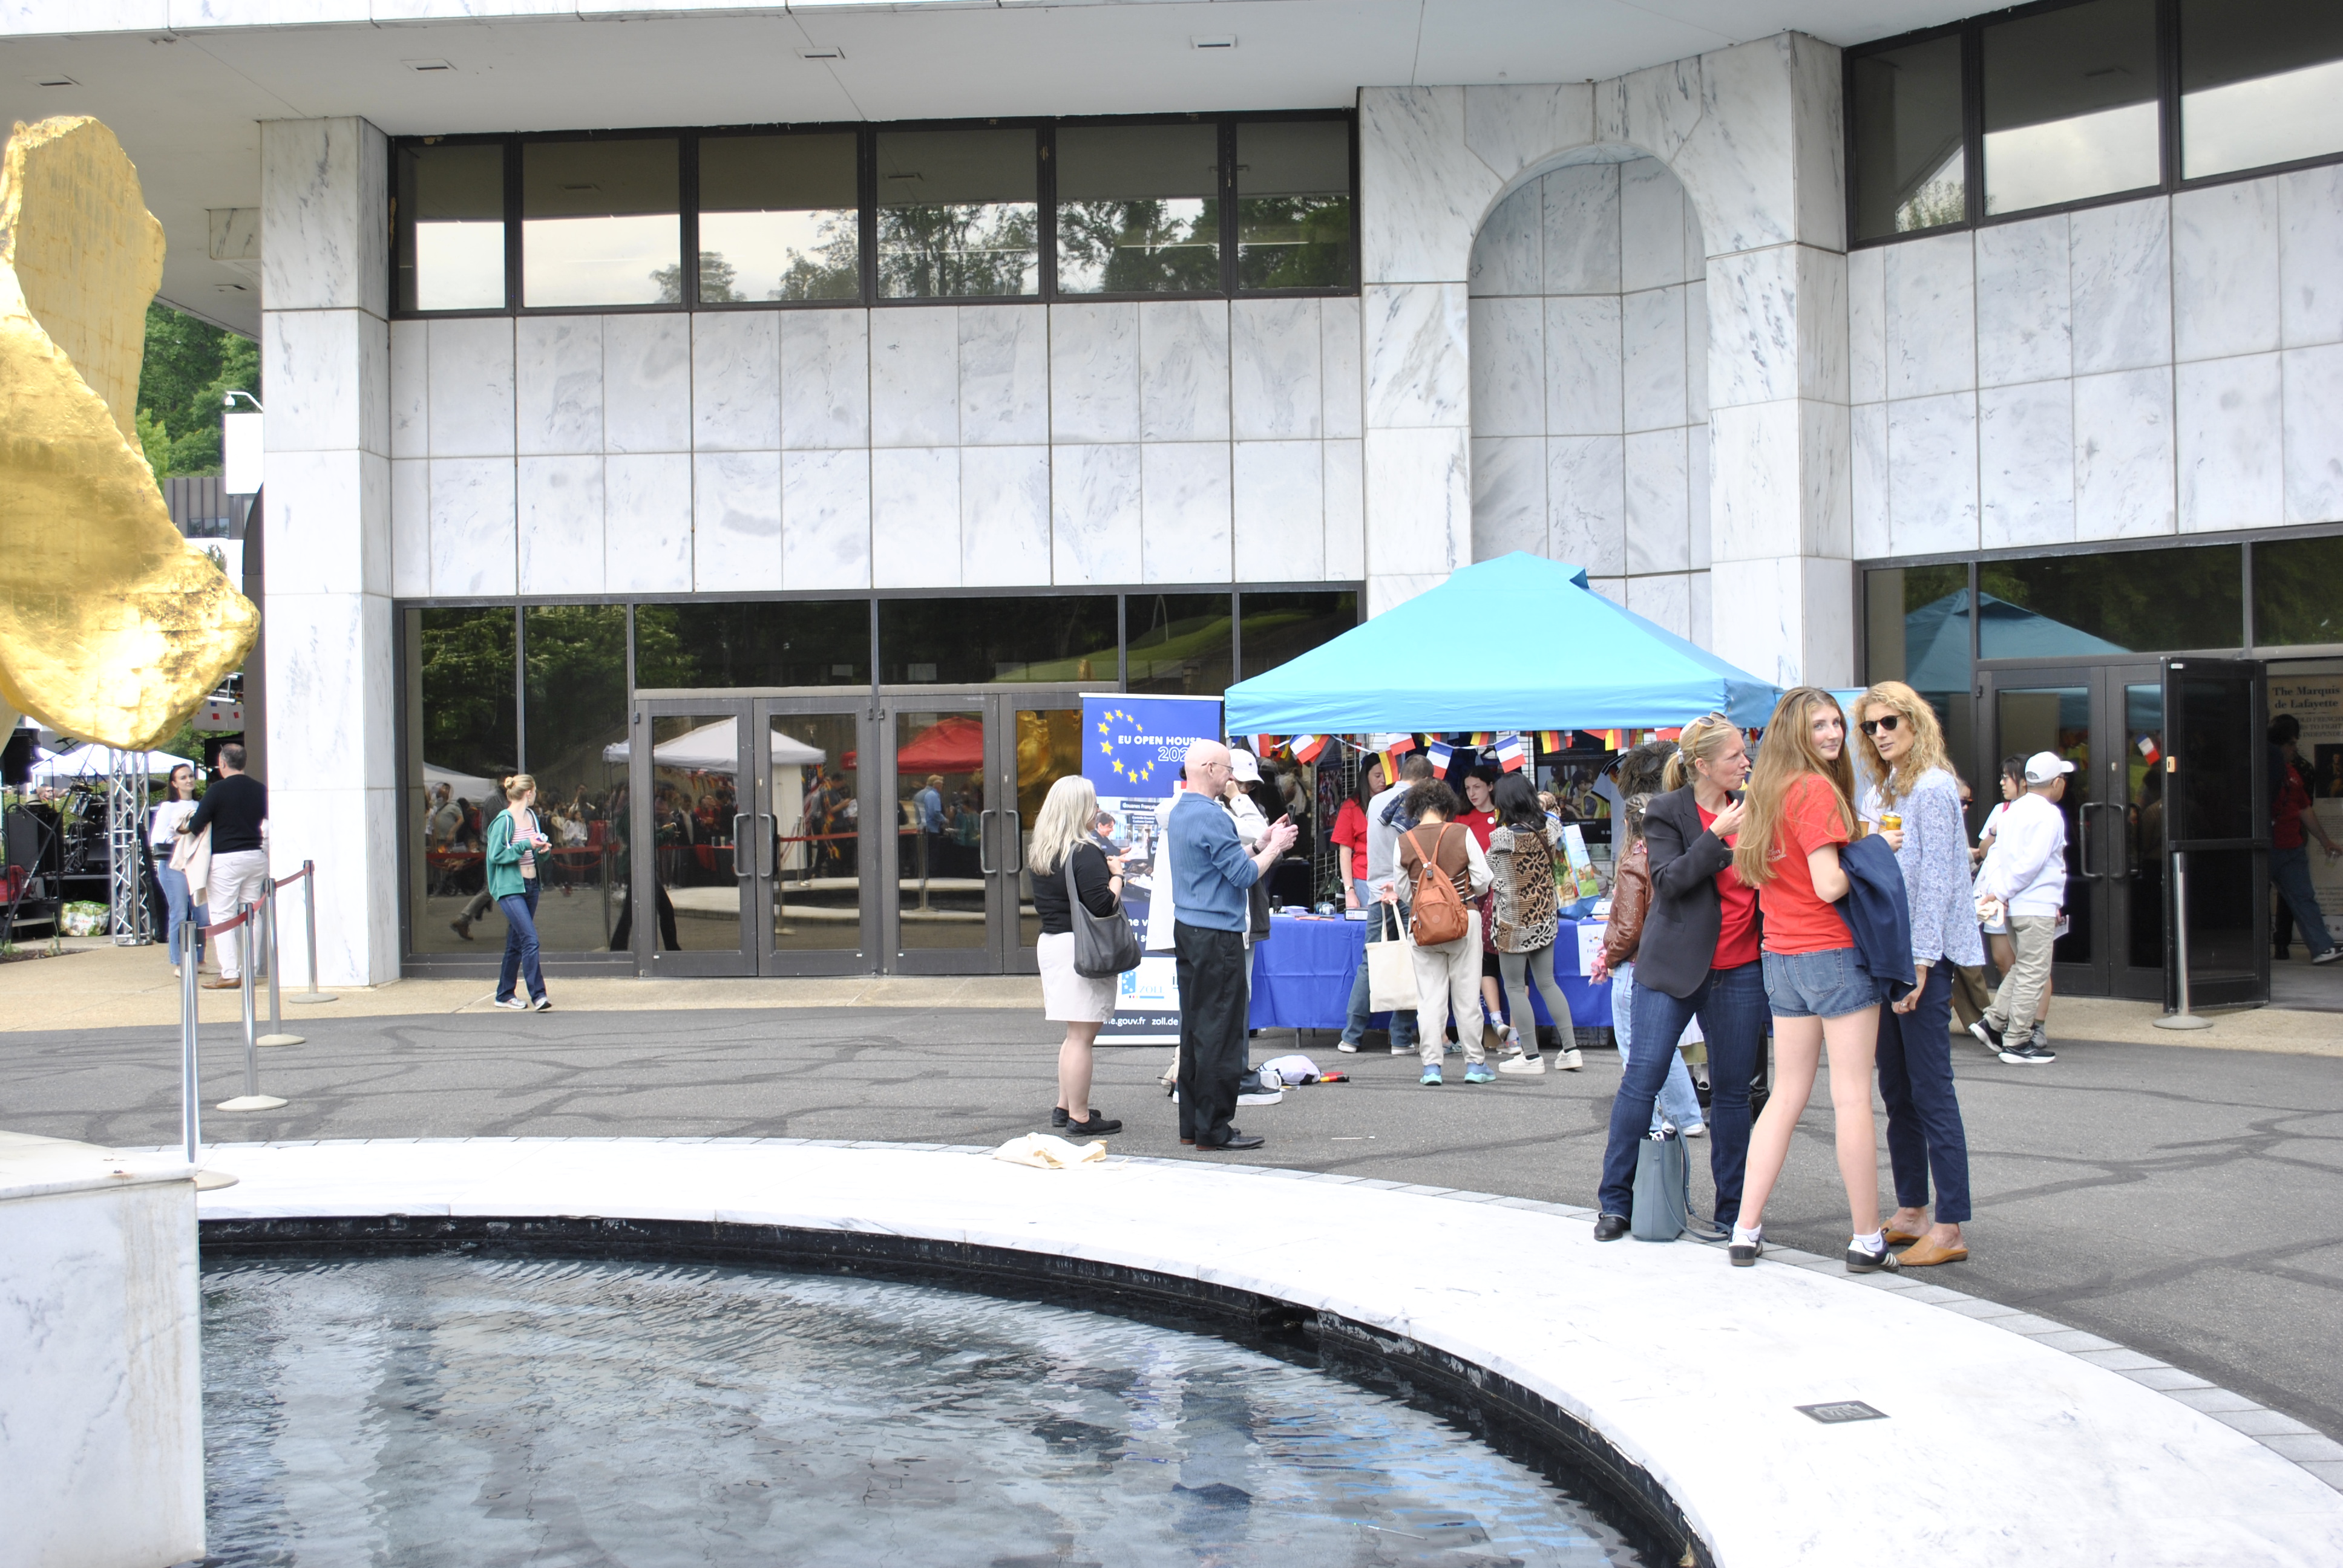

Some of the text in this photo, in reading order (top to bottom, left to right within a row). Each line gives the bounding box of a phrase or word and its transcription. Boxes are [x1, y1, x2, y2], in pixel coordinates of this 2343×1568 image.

[2272, 685, 2340, 697] The Marquis
[2275, 698, 2338, 710] de Lafayette
[1118, 735, 1202, 746] EU OPEN HOUS
[1158, 746, 1188, 762] 202
[1152, 1016, 1179, 1026] zoll.de
